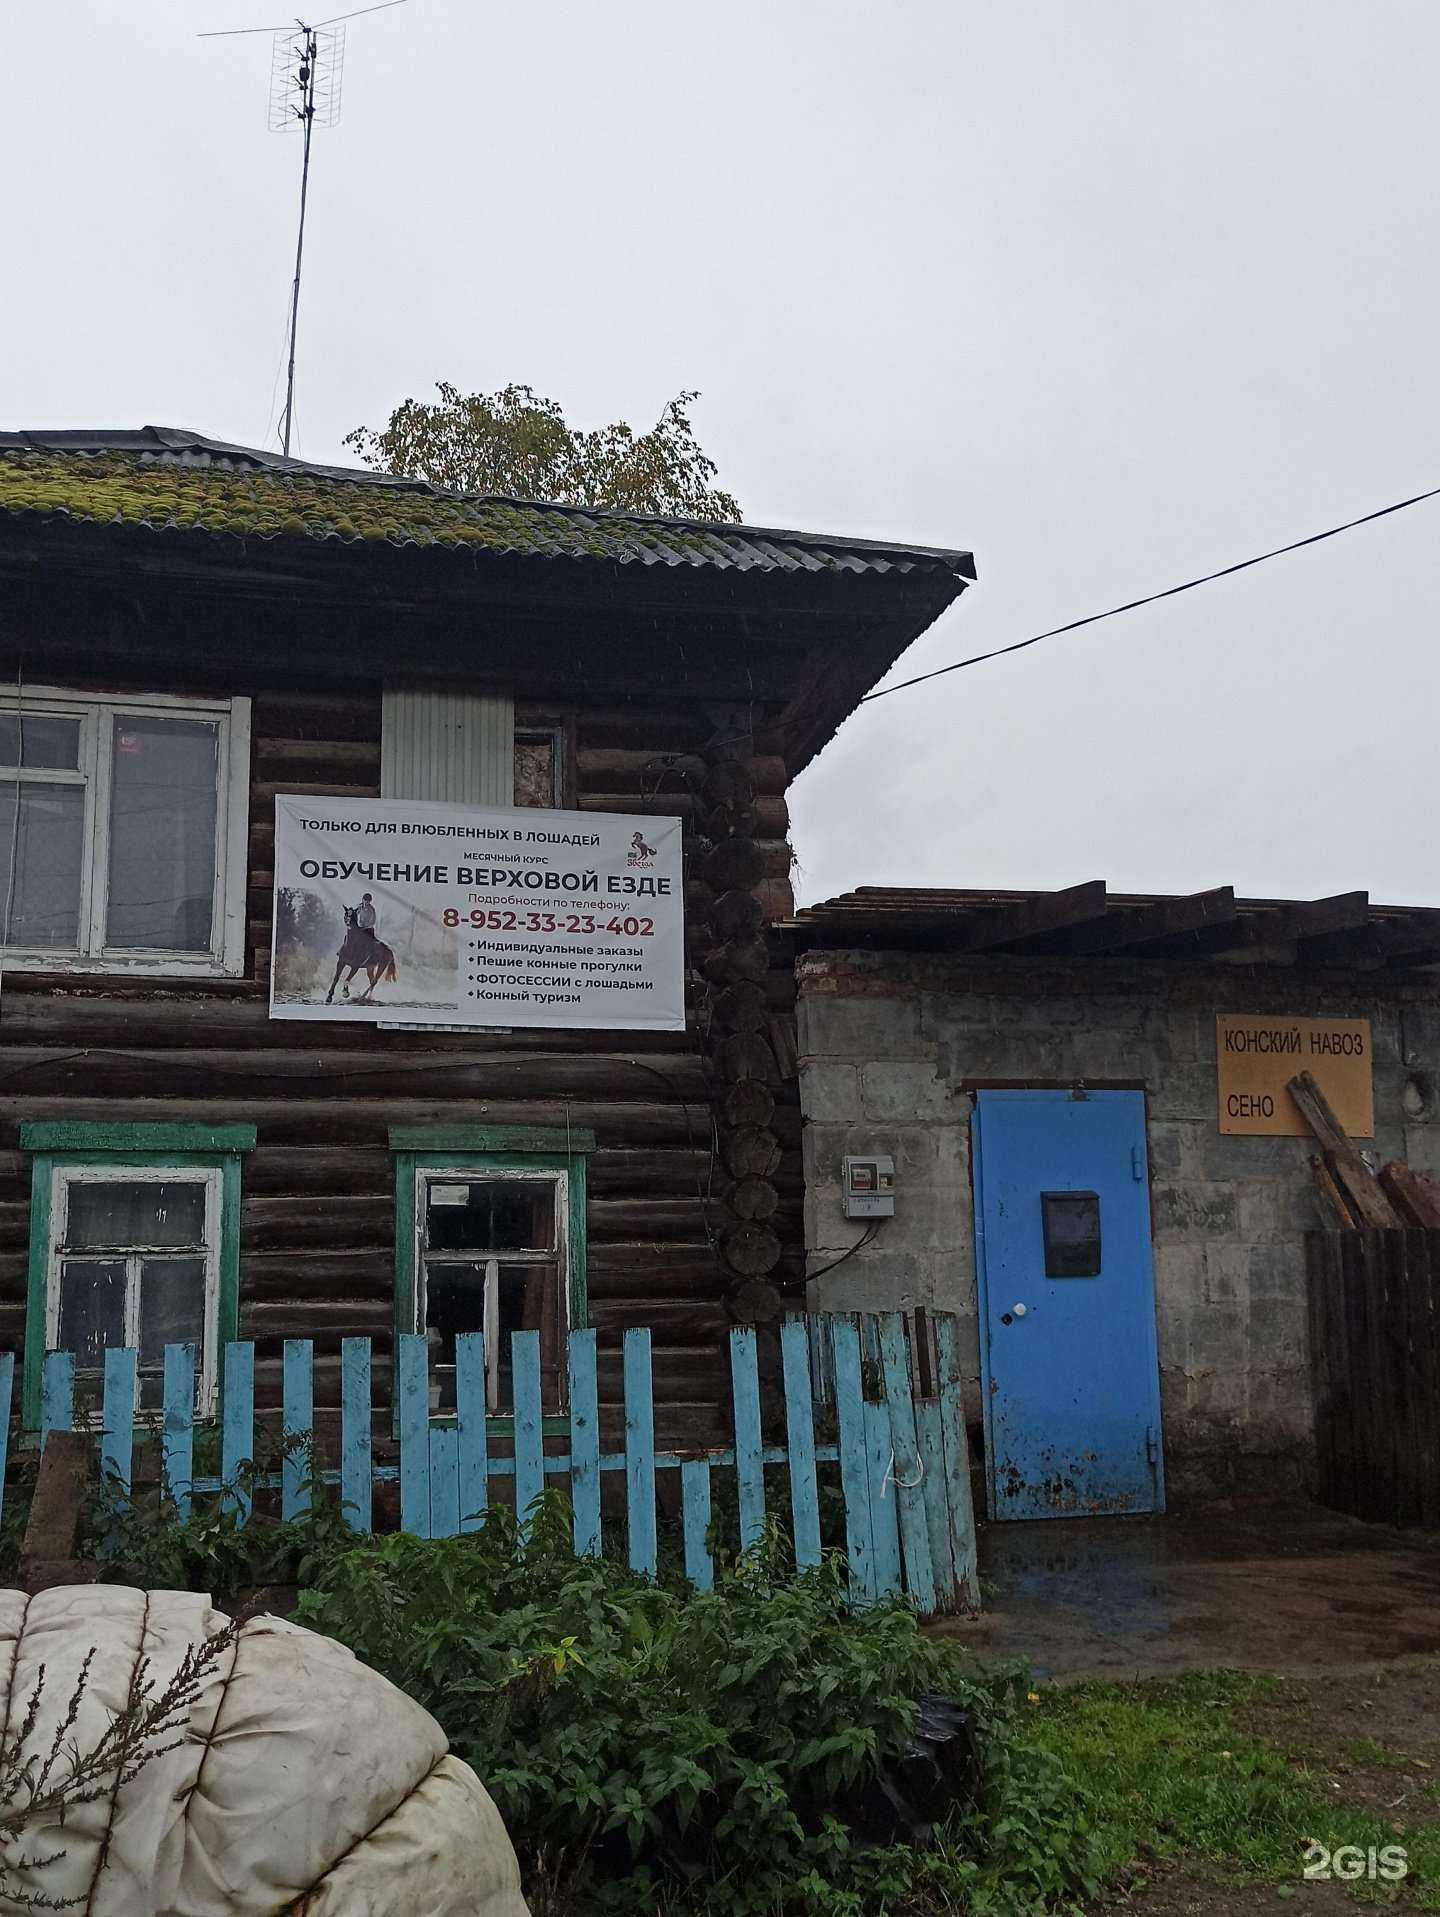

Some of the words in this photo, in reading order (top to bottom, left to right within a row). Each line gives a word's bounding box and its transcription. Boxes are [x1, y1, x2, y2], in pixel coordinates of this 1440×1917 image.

[299, 819, 362, 832] ТОЛЬКО
[365, 822, 397, 834] ДЛЯ
[401, 824, 510, 840] ВЛЮБЛЕННЫХ
[513, 830, 523, 841] В
[526, 831, 600, 847] ЛОШАДЕЙ
[464, 851, 521, 863] МЕСЯЧНЫЙ
[523, 855, 549, 865] КУРС
[299, 859, 449, 884] ОБУЧЕНИЕ
[457, 867, 598, 892] ВЕРХОВОЙ
[607, 875, 672, 897] ЕЗДЕ
[468, 893, 550, 906] Подробности
[553, 898, 567, 907] по
[570, 899, 631, 911] телефону:
[443, 908, 655, 937] 8-952-33-23-402
[477, 940, 594, 955] Индивидуальные
[597, 947, 644, 957] заказы
[477, 955, 523, 967] Пешие
[527, 959, 577, 969] конные
[580, 961, 643, 972] прогулки
[476, 973, 571, 987] ФОТОСЕССИИ
[574, 980, 583, 988] с
[585, 979, 654, 990] лошадьми
[476, 989, 530, 1001] Конный
[532, 993, 581, 1004] туризм
[1225, 1027, 1302, 1053] КОНСКИЙ
[1310, 1032, 1364, 1056] НАВОЗ
[1227, 1094, 1274, 1118] СЕНО
